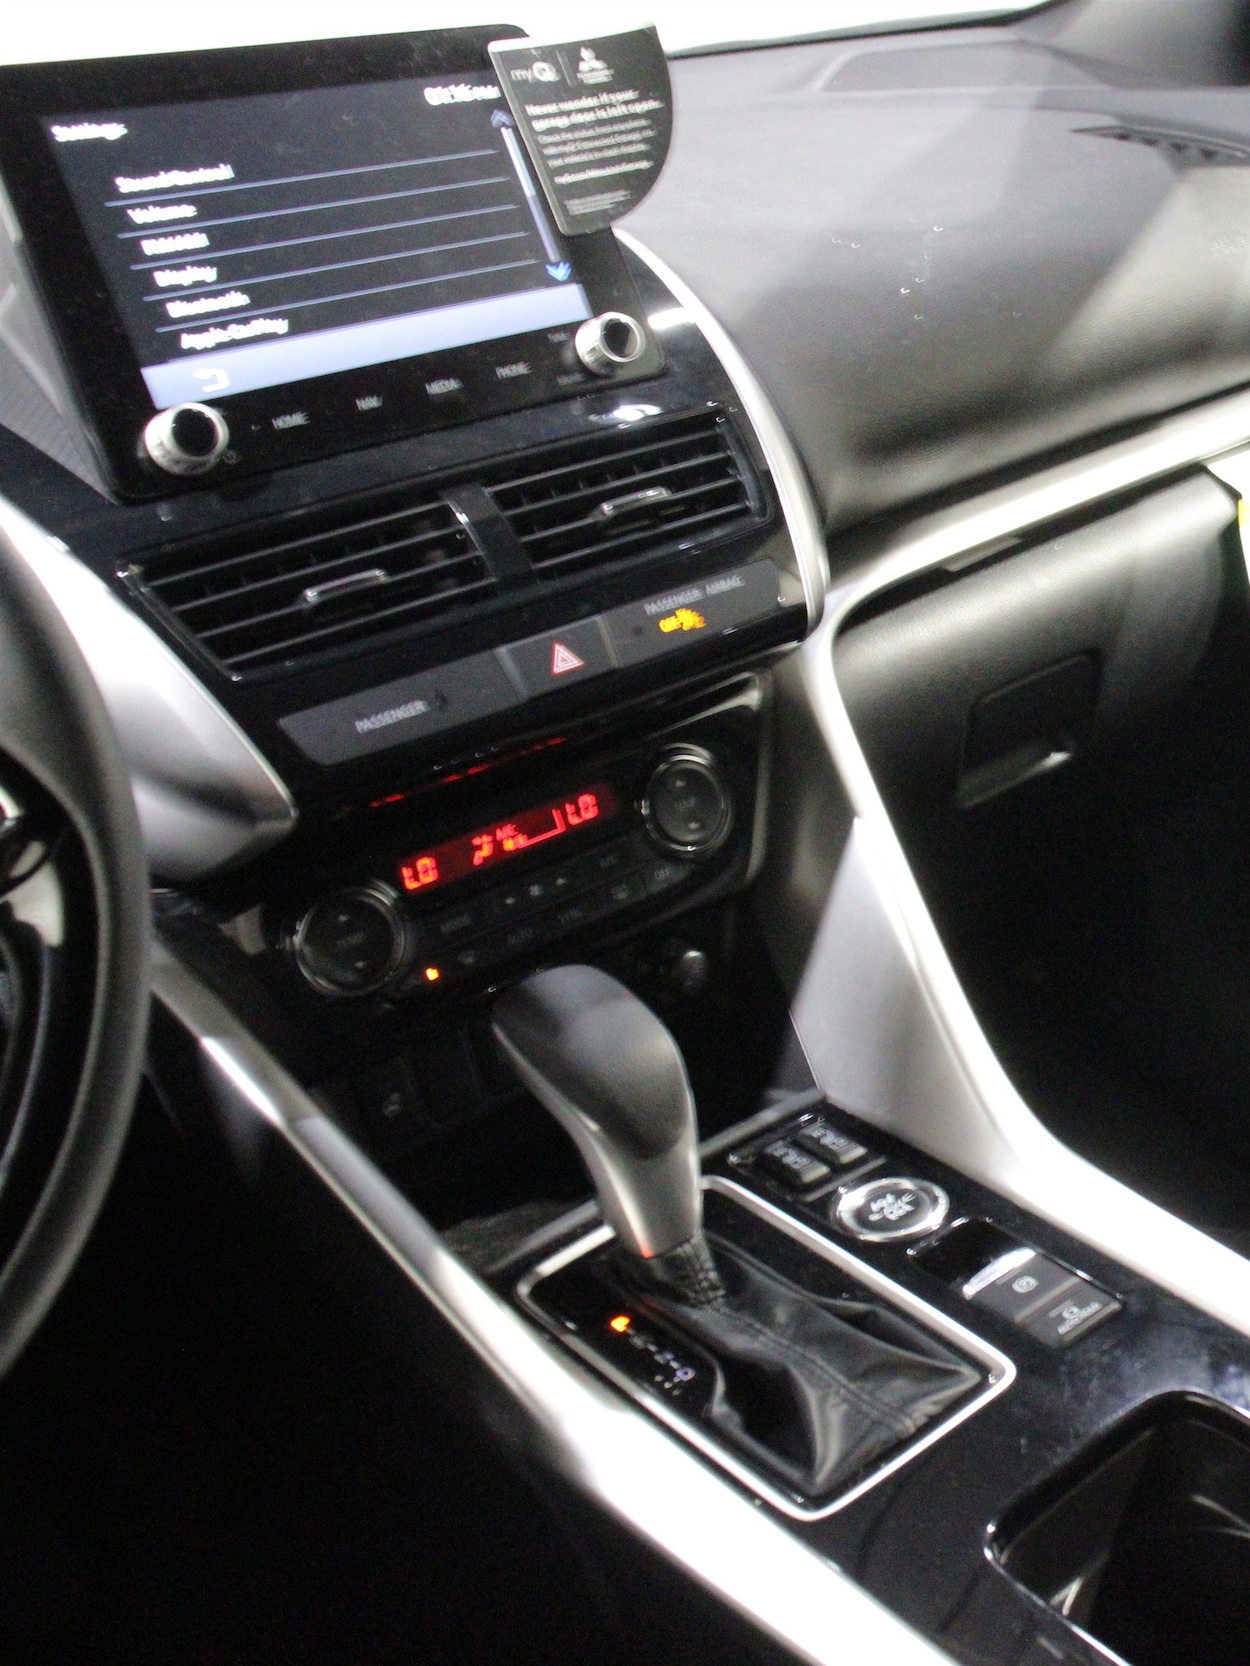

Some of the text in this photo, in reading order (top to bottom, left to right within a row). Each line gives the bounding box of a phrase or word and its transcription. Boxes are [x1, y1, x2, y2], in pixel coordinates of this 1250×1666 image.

[510, 61, 561, 83] myQ
[525, 101, 558, 116] Never
[559, 96, 599, 113] wonder
[609, 90, 639, 104] your
[532, 115, 569, 132] garage
[570, 112, 597, 126] door
[606, 104, 629, 118] left
[51, 122, 129, 143] Settings
[495, 361, 535, 379] PHONE
[425, 377, 464, 395] MEDIA
[271, 411, 311, 430] HOME
[643, 575, 746, 616] PASSENGER AIRBAG
[354, 700, 431, 734] PASSENGER
